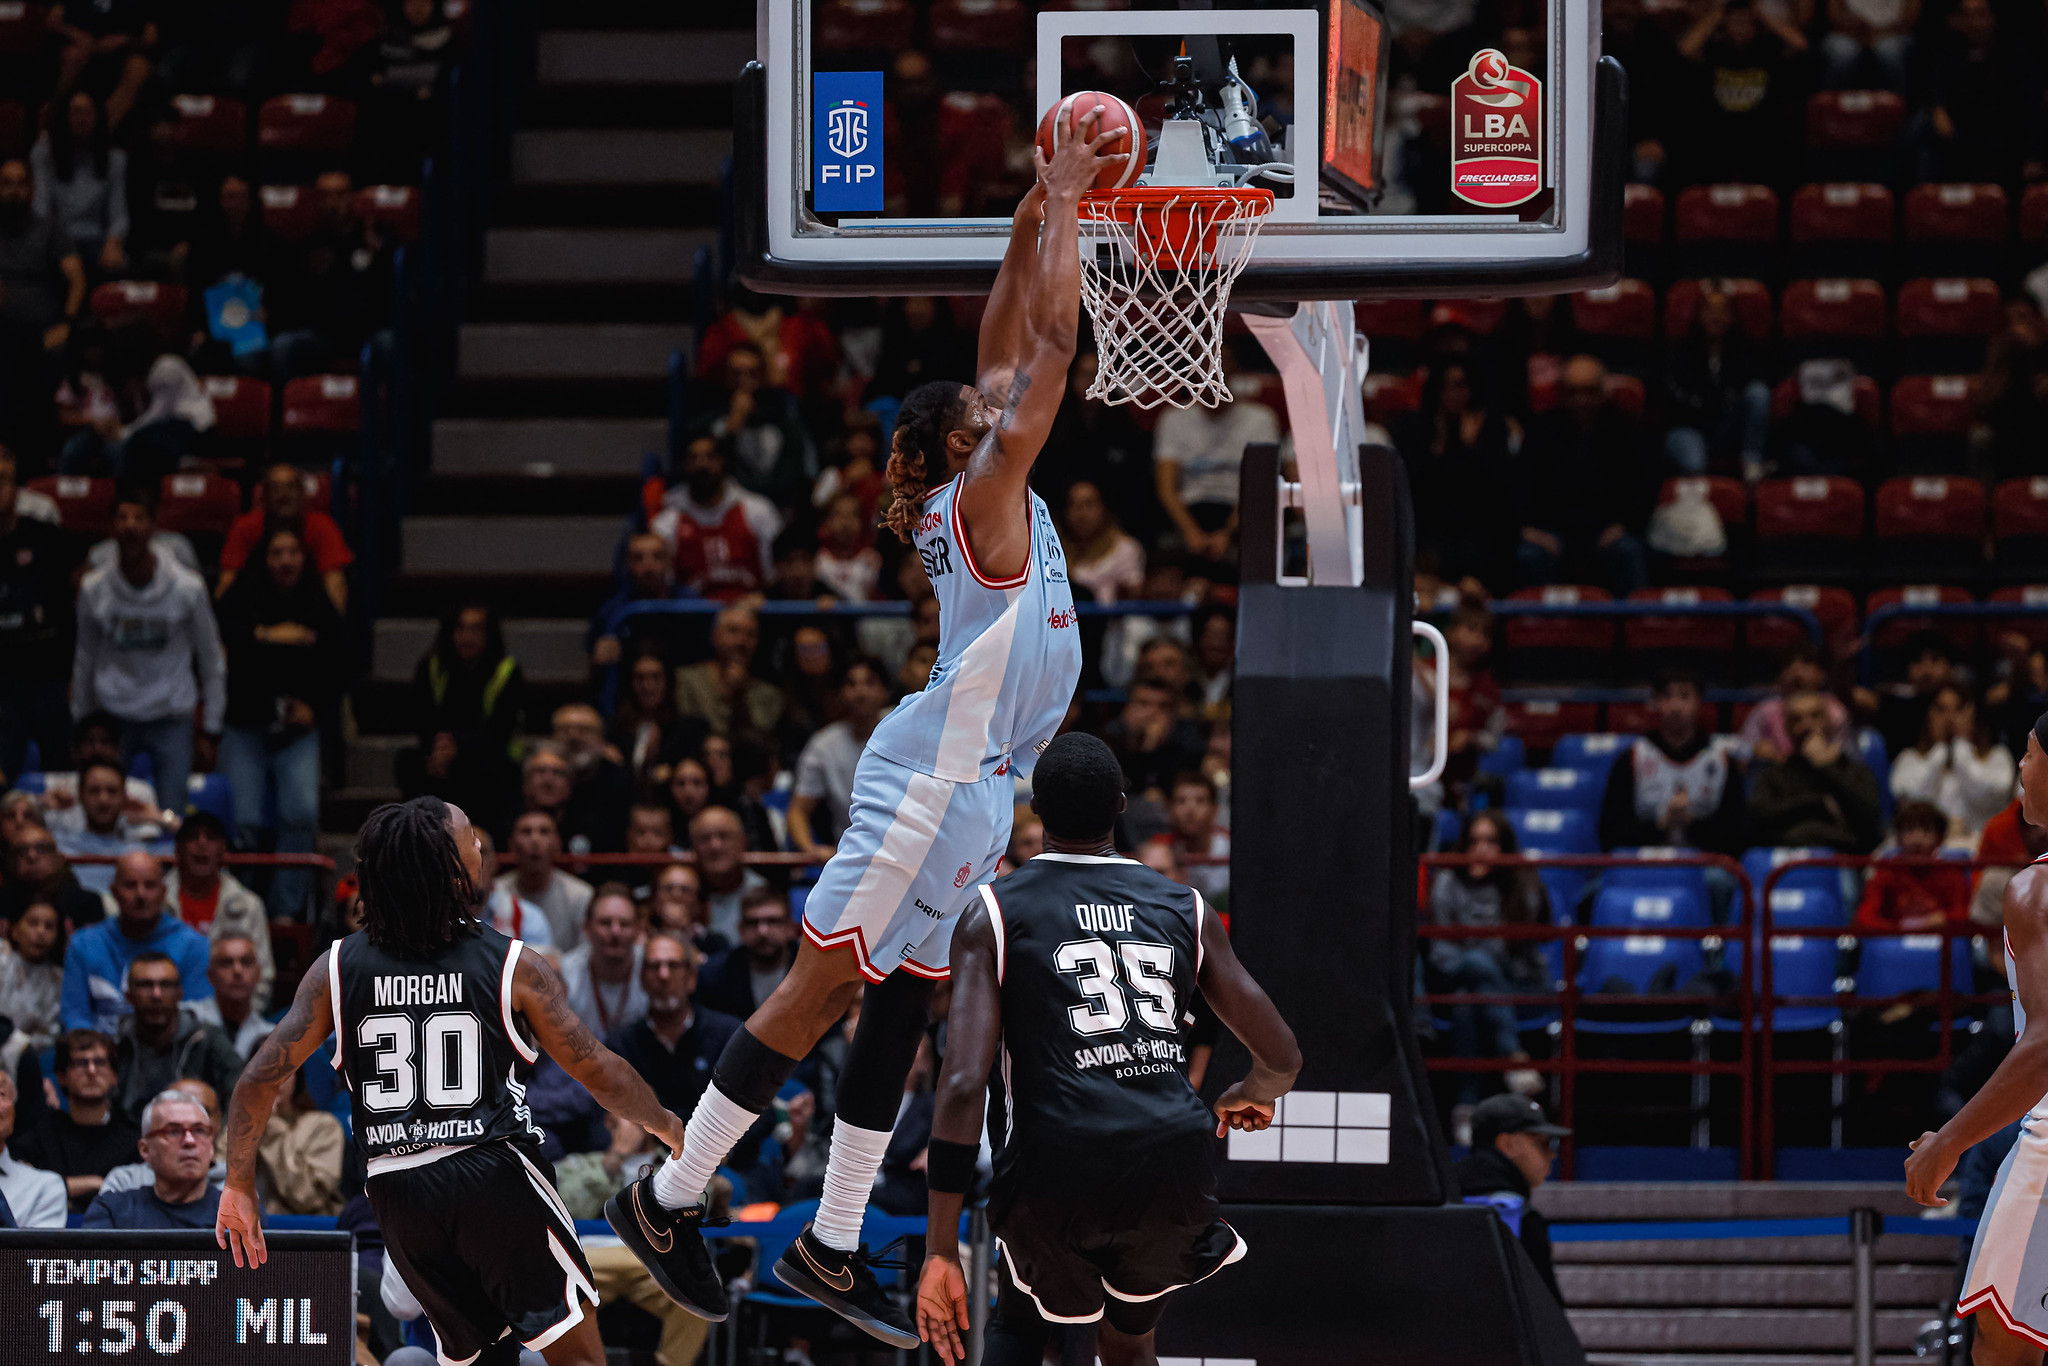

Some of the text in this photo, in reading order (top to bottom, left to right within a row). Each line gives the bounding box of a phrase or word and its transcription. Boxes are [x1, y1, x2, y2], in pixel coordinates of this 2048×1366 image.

[1464, 113, 1530, 138] LBA
[1463, 143, 1532, 153] SUPERCOPPA
[821, 164, 876, 184] FIP
[1458, 174, 1537, 183] FRECCIAROSSA
[1074, 903, 1135, 933] DIOUF
[374, 972, 463, 1007] MORGAN
[1053, 937, 1179, 1037] 35
[356, 1011, 483, 1113] 30
[1074, 1042, 1134, 1070] SAVOIA
[1115, 1063, 1176, 1079] BOLOGNA
[426, 1118, 484, 1140] HOTELS
[27, 1258, 218, 1285] TEMPO SUPP
[37, 1298, 328, 1355] 1:50 MIL
